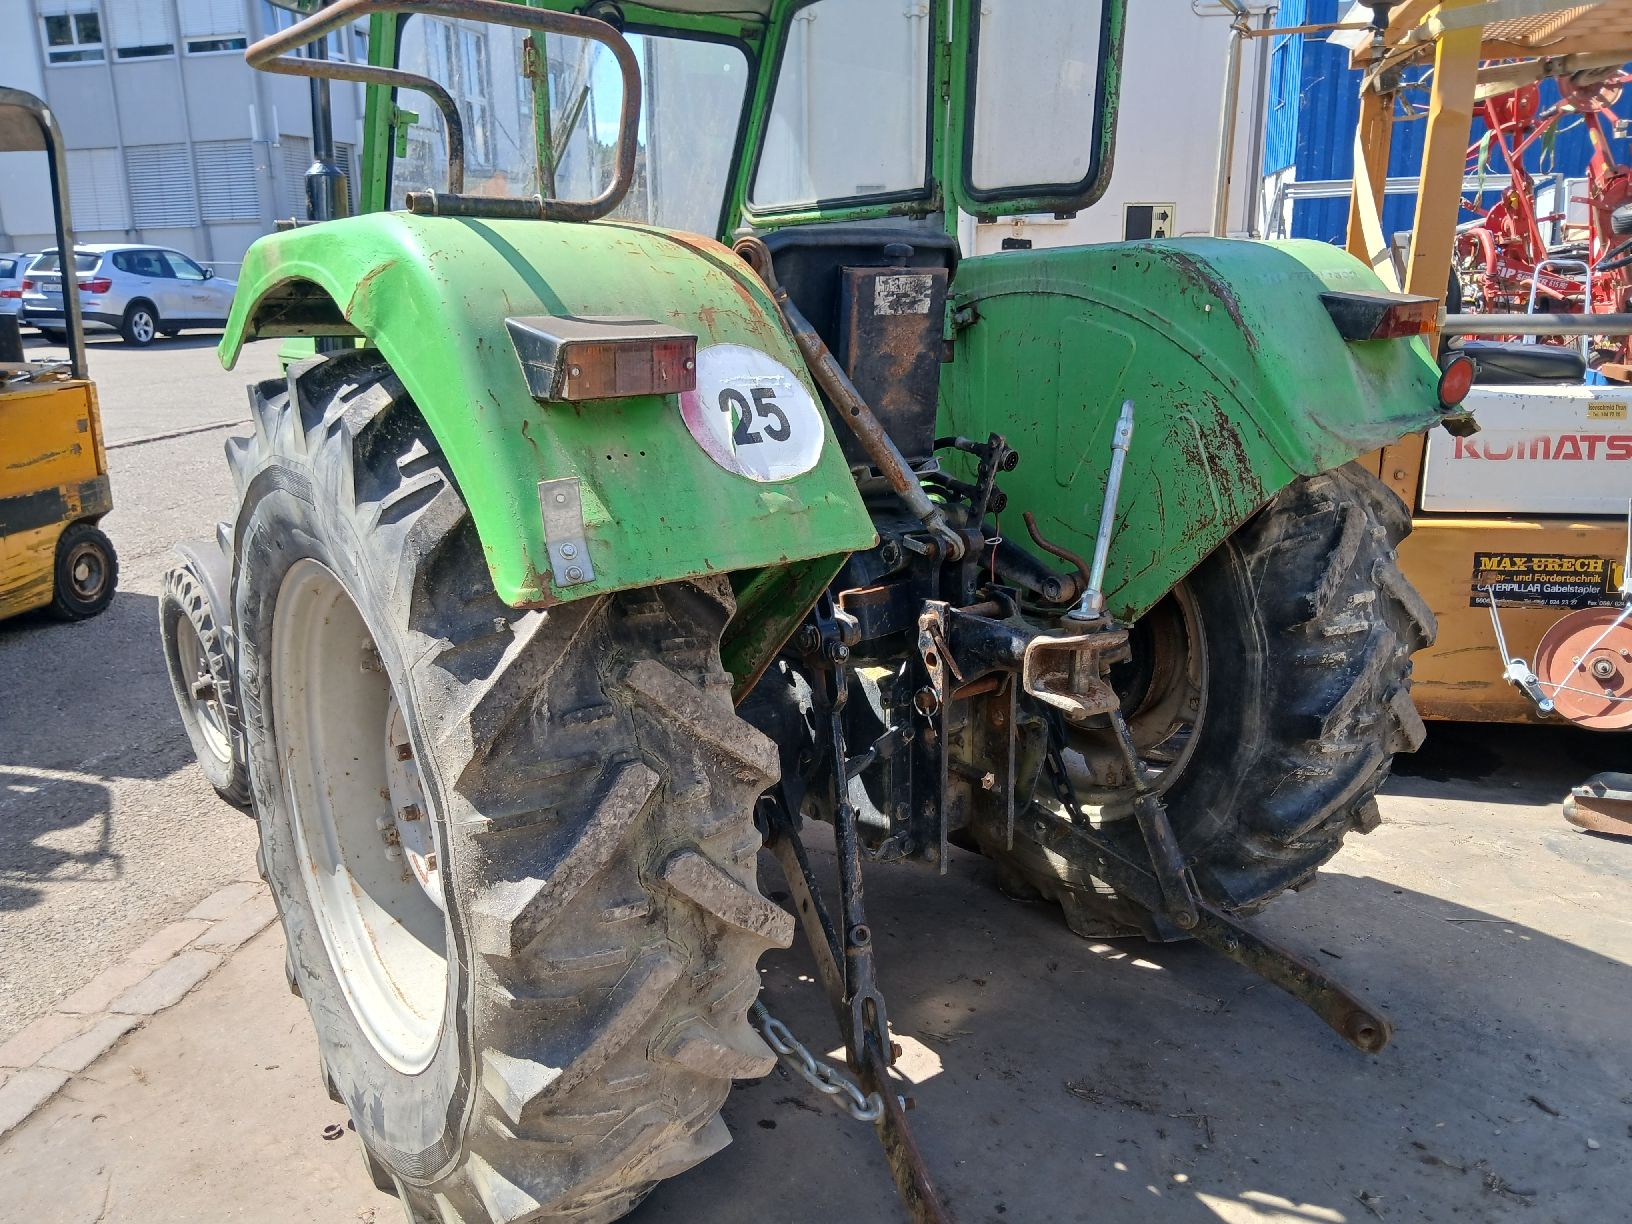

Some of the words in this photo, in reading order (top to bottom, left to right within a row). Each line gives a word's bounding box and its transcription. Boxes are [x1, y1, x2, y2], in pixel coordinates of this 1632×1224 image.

[718, 387, 791, 446] 25
[1479, 557, 1528, 571] MAX
[1532, 558, 1605, 572] URECH
[1513, 573, 1534, 583] und
[1534, 573, 1601, 583] Fördertechnik
[1477, 583, 1541, 593] CATERPILLAR
[1543, 583, 1601, 595] Gabelstapler
